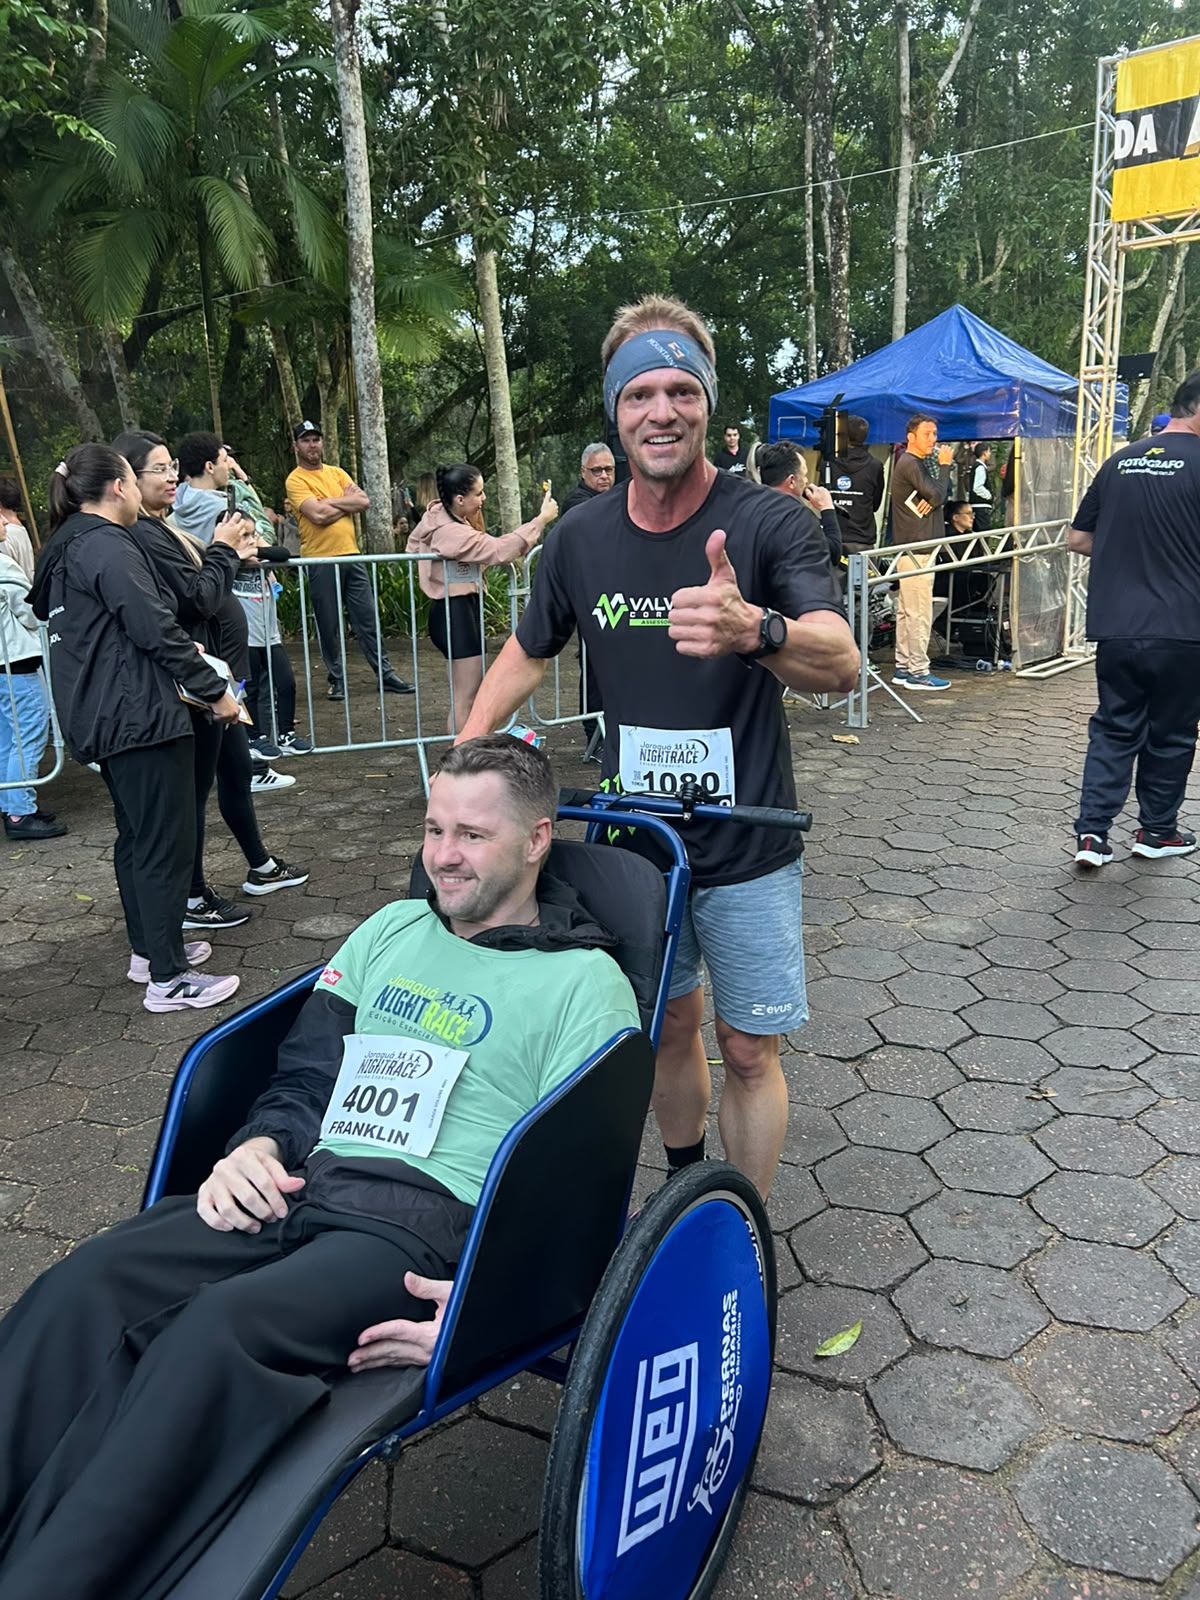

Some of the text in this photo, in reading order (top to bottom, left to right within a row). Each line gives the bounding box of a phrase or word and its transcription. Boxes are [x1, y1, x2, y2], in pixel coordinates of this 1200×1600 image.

[1113, 113, 1158, 160] DA
[1117, 456, 1185, 469] FOTÓGRAFO
[639, 749, 699, 764] NIGHTRACE
[643, 770, 720, 795] 1080
[389, 974, 440, 999] Jaraguá
[369, 1010, 434, 1041] Edição Especial
[356, 1058, 421, 1080] NIGHTRACE
[342, 1084, 420, 1123] 4001
[328, 1121, 410, 1146] FRANKLIN
[720, 1292, 732, 1424] PERNAS
